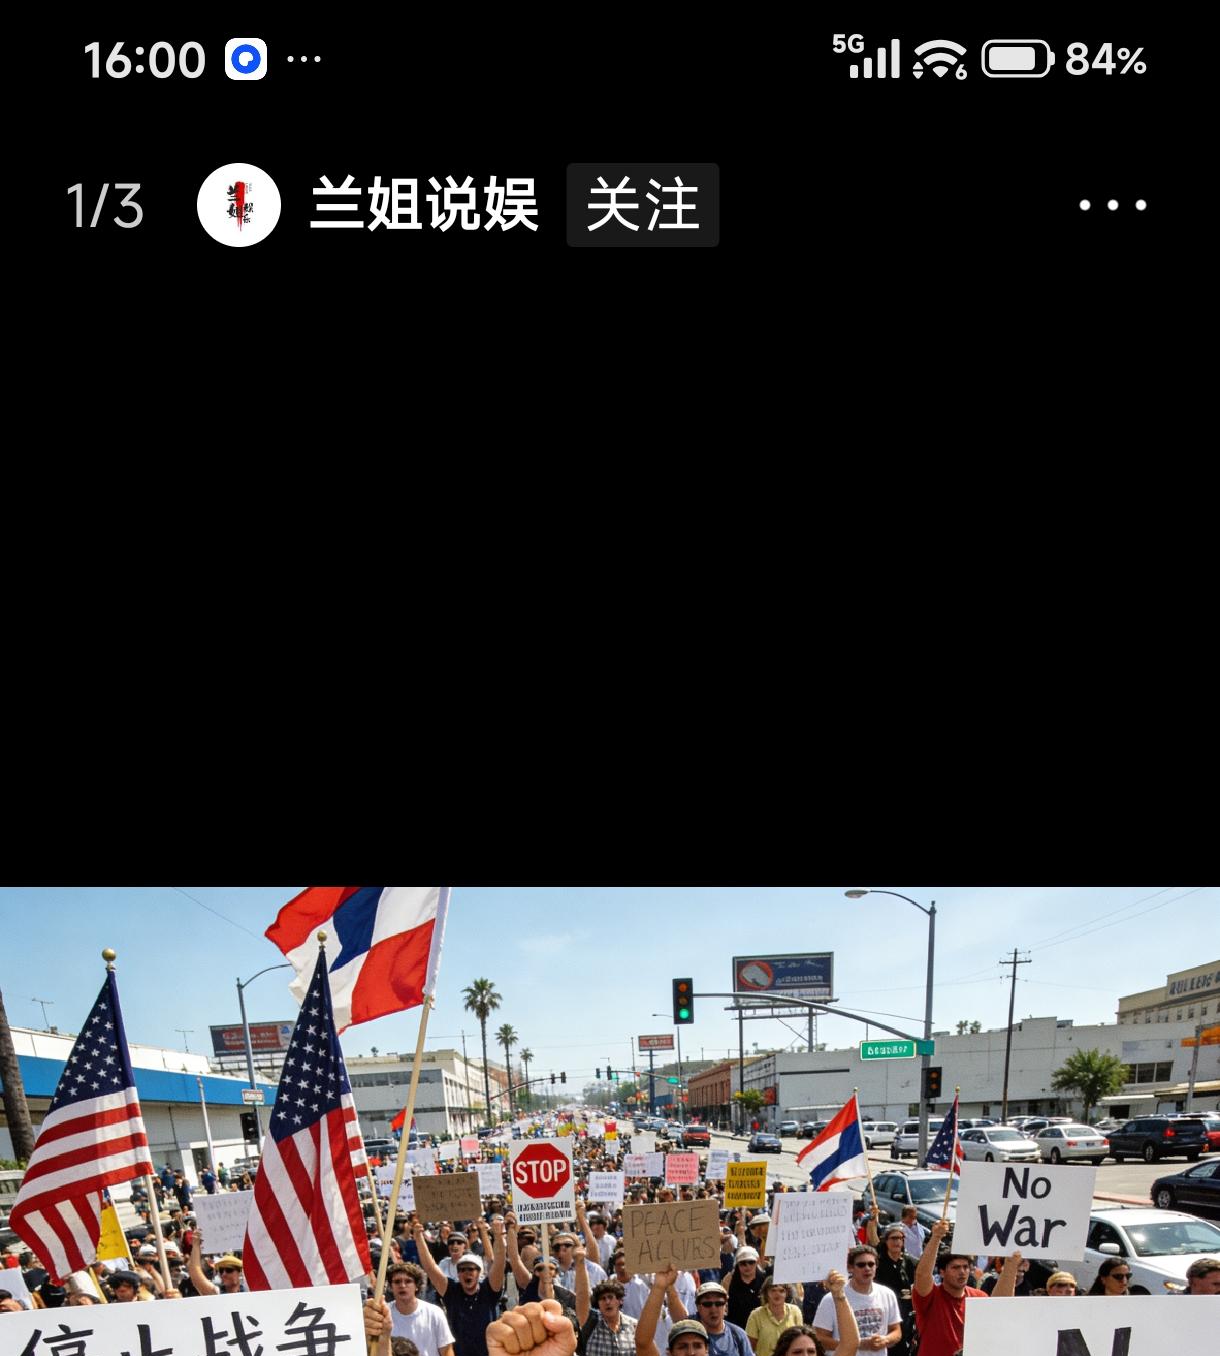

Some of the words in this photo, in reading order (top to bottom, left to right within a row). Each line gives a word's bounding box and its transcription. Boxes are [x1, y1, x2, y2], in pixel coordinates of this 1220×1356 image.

[85, 41, 205, 78] 16:00
[833, 34, 865, 54] 5G
[1065, 42, 1147, 76] 84%
[67, 183, 144, 229] 1/3
[310, 174, 539, 233] 兰姐说娱
[587, 176, 700, 232] 关注
[515, 1159, 567, 1185] STOP
[1002, 1167, 1052, 1200] No
[631, 1206, 705, 1238] PEACE
[977, 1204, 1067, 1249] War
